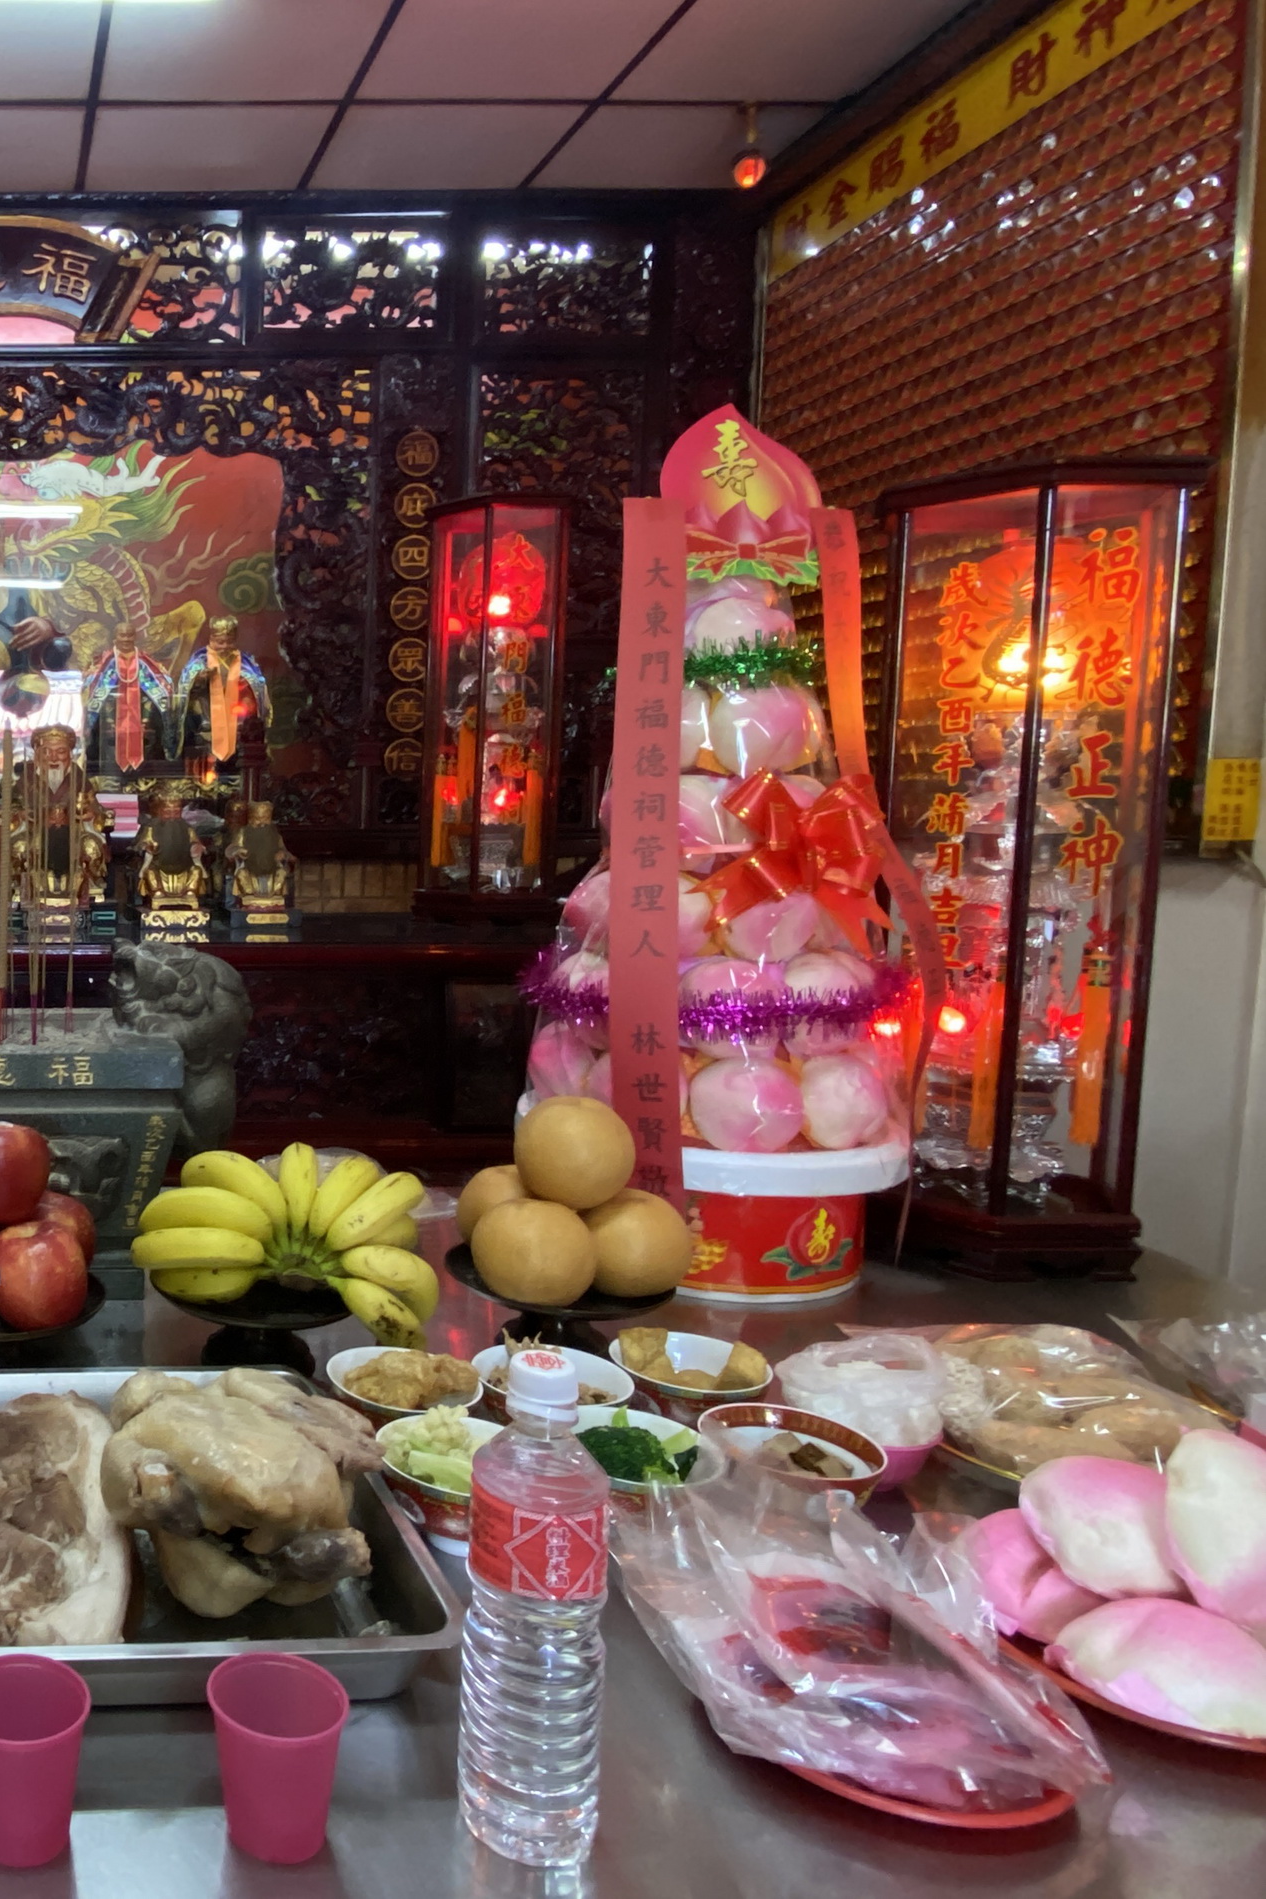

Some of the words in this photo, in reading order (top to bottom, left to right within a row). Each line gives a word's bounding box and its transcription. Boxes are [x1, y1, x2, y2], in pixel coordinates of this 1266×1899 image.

[1008, 0, 1174, 111] 財神
[628, 556, 675, 960] 大東門福德祠管理人
[1058, 526, 1141, 898] 福德正神
